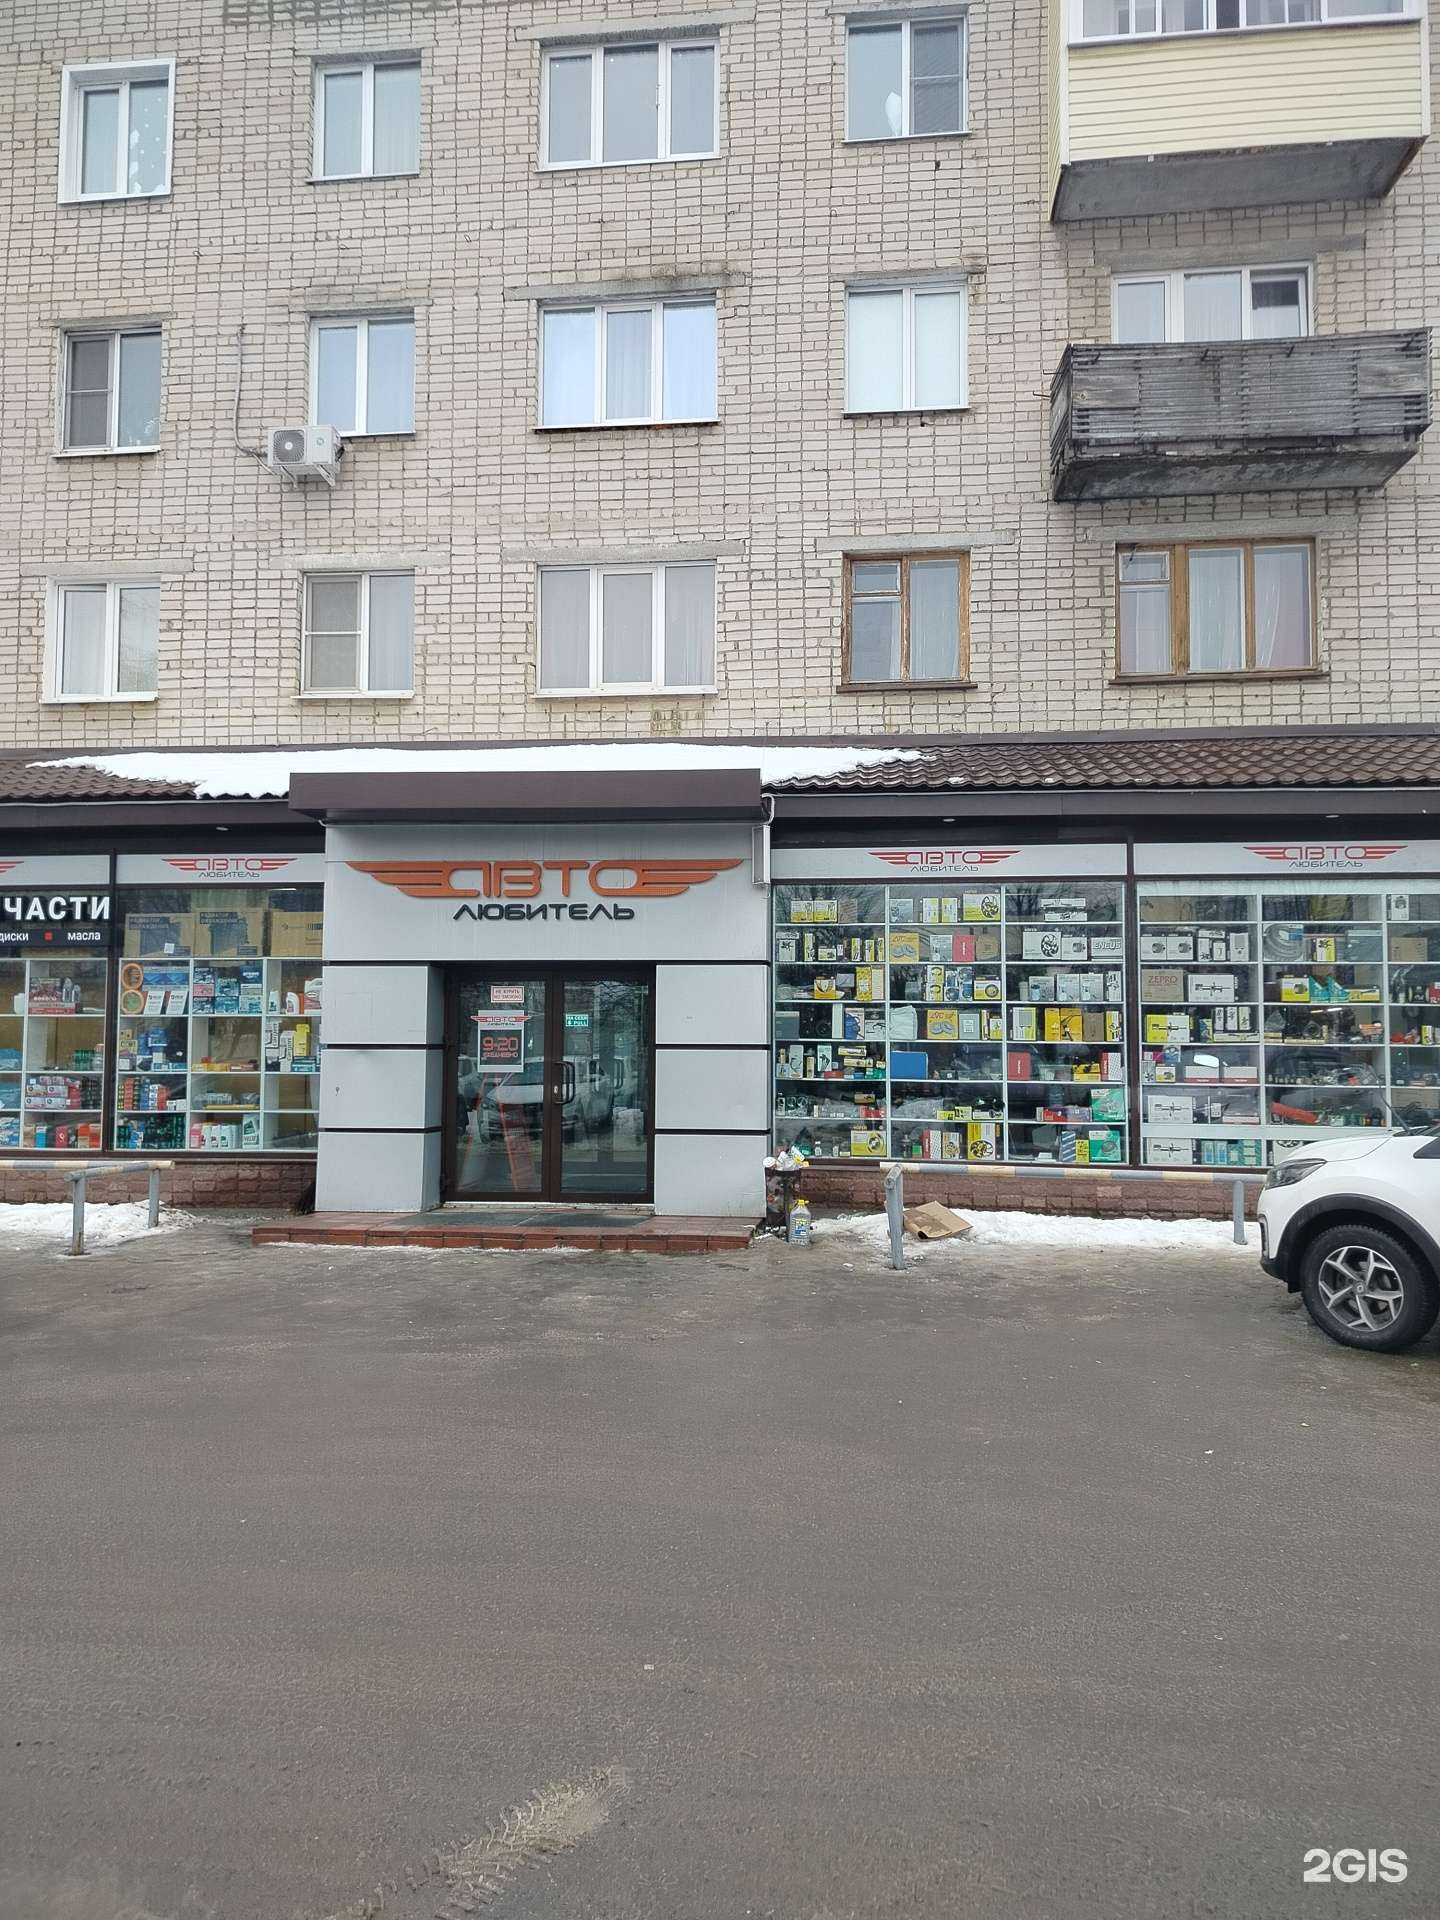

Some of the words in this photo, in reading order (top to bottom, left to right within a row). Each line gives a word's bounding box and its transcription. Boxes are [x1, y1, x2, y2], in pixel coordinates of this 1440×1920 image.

[905, 851, 982, 865] АВТО
[1283, 846, 1367, 860] АВТО
[193, 858, 263, 871] АВТО
[910, 865, 979, 873] ЛЮБИТЕЛЬ
[1289, 860, 1364, 868] ЛЮБИТЕЛЬ
[444, 860, 644, 898] АВТО
[4, 896, 110, 920] ЧАСТИ
[453, 903, 635, 921] ЛЮБИТЕЛЬ
[67, 932, 101, 941] масла
[1148, 975, 1178, 984] ZEPRO
